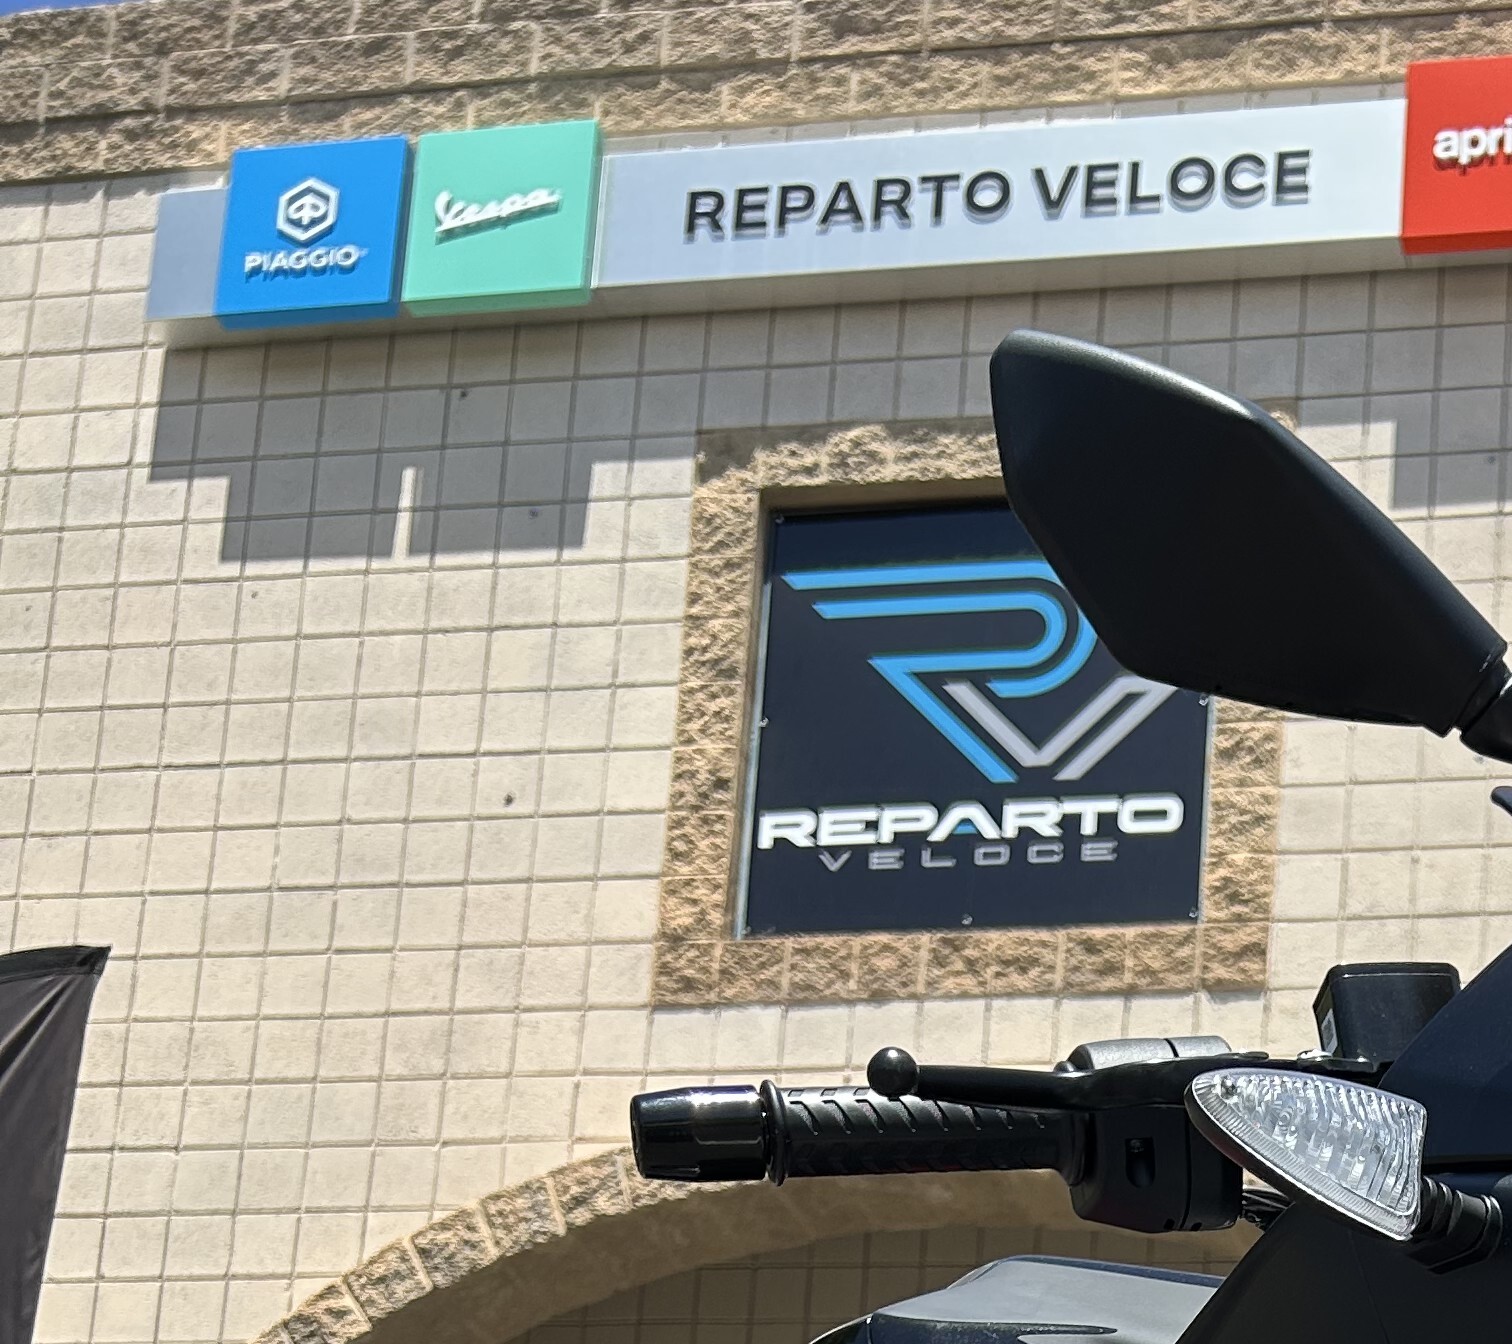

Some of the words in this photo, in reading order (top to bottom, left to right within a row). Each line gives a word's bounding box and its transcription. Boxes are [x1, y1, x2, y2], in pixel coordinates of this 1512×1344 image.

[434, 185, 564, 236] Vespa
[685, 170, 1012, 242] REPARTO
[1033, 149, 1312, 220] VELOCE
[244, 244, 360, 278] PIAGGIO
[757, 792, 1184, 850] REPARTO
[818, 839, 1119, 872] VELOCE
